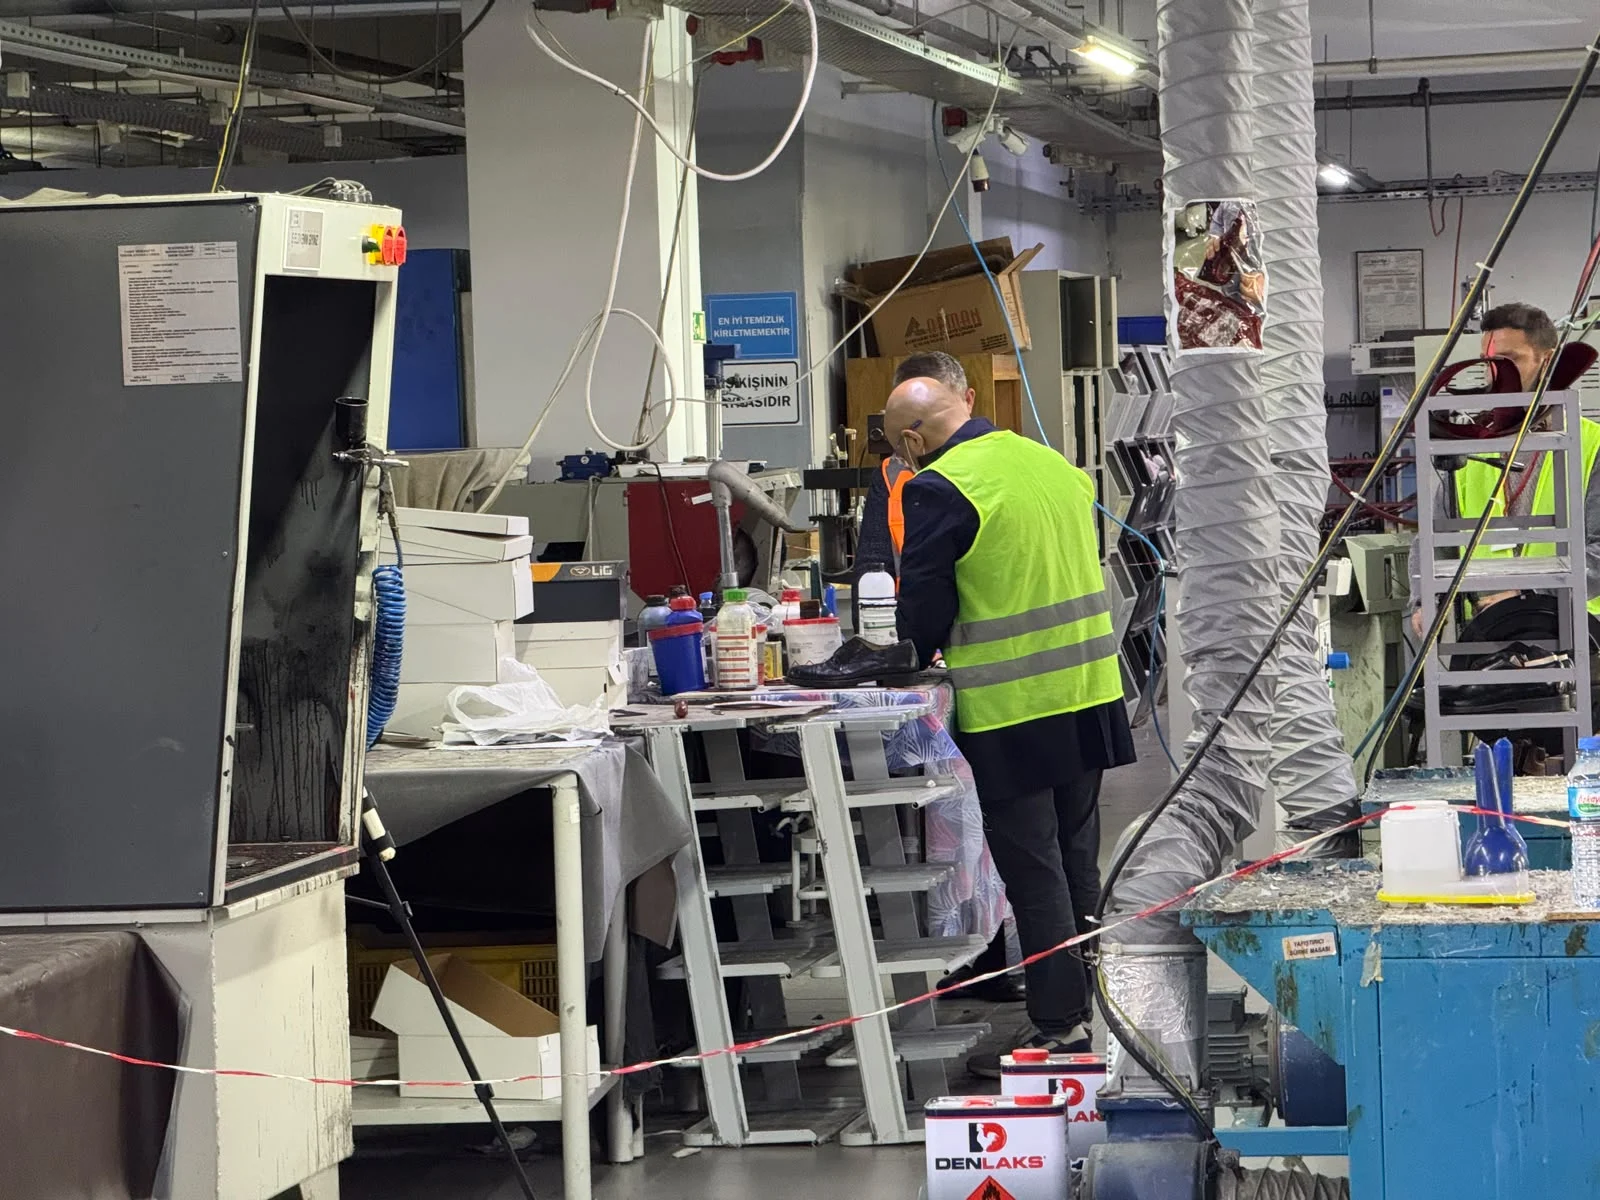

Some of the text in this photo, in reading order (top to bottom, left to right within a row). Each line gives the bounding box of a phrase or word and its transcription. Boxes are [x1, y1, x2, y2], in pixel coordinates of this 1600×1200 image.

[718, 315, 785, 326] EN İYİ TEMİZLİK
[713, 327, 790, 338] KİRLETMEMEKTİR
[739, 373, 788, 391] KİŞİNİN
[935, 1156, 1044, 1170] DENLAKS
